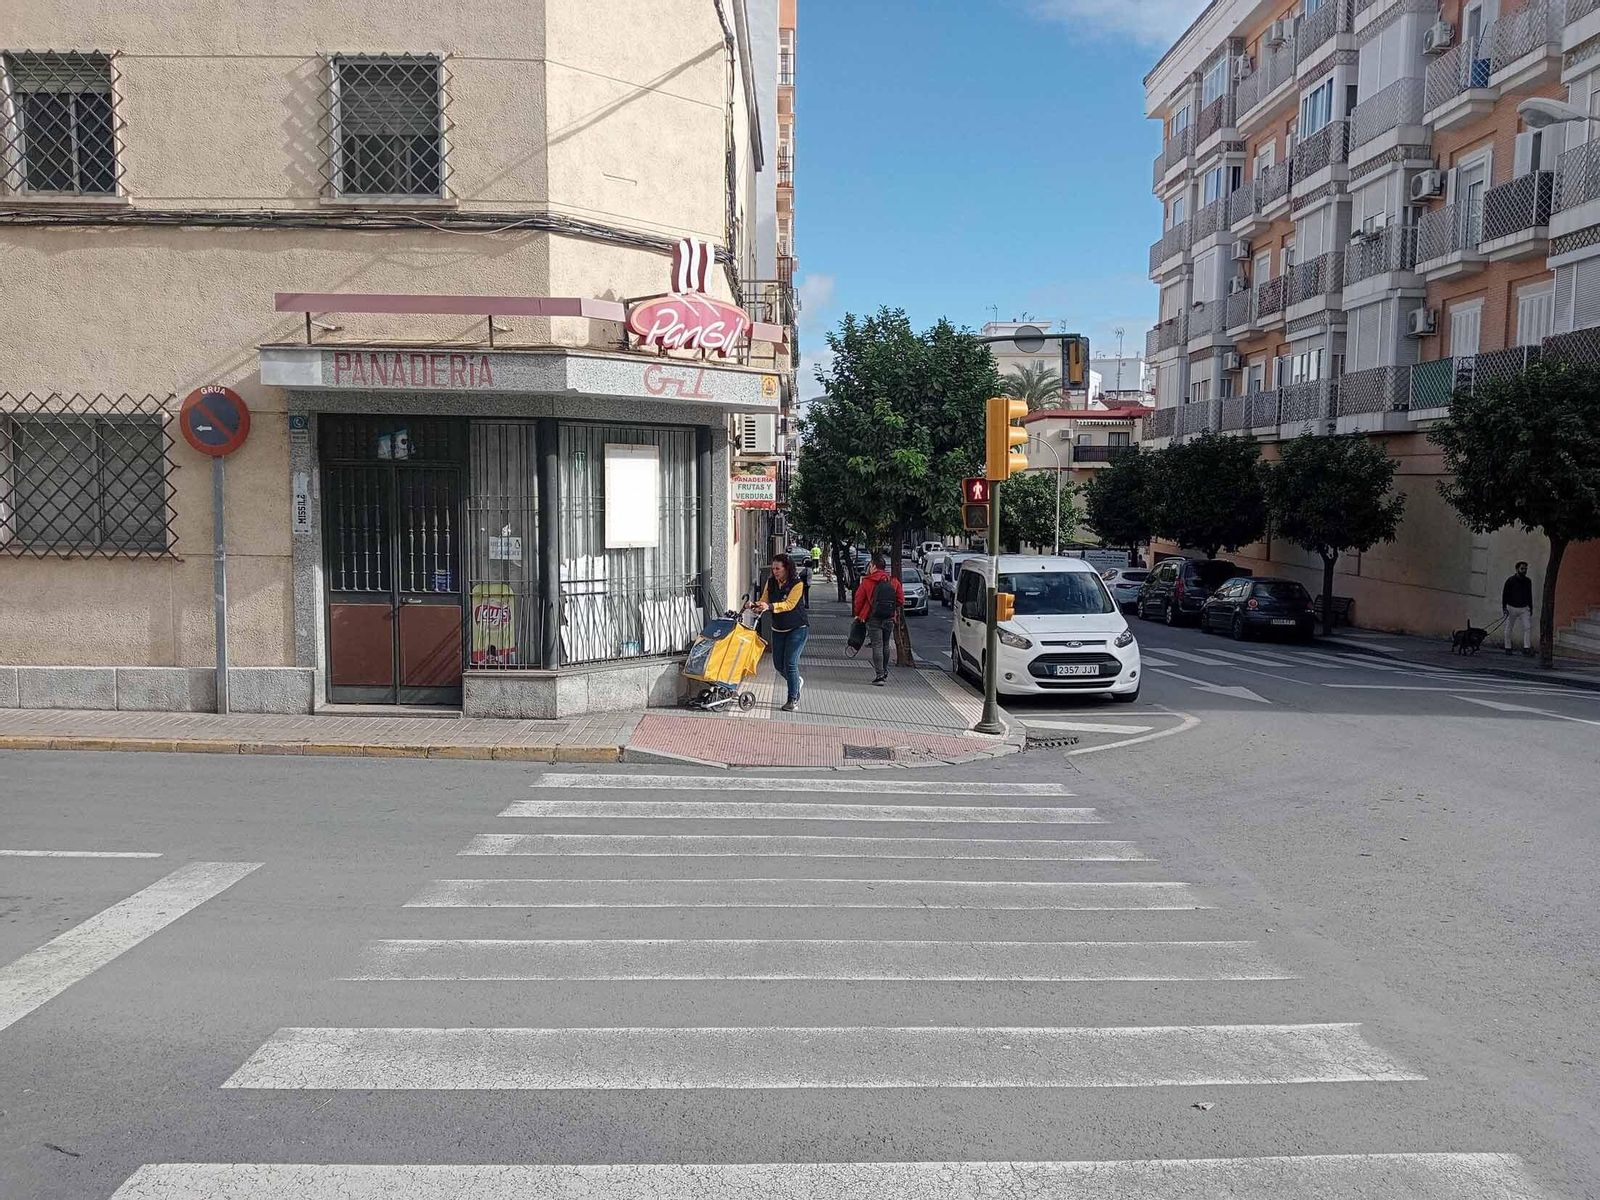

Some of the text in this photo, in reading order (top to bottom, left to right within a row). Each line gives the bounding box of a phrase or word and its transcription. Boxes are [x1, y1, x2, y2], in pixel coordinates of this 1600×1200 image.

[200, 385, 227, 396] GRUA
[738, 483, 772, 491] FRUTAS Y
[735, 492, 774, 500] VERDURAS
[1059, 666, 1097, 674] 2357 JJV
